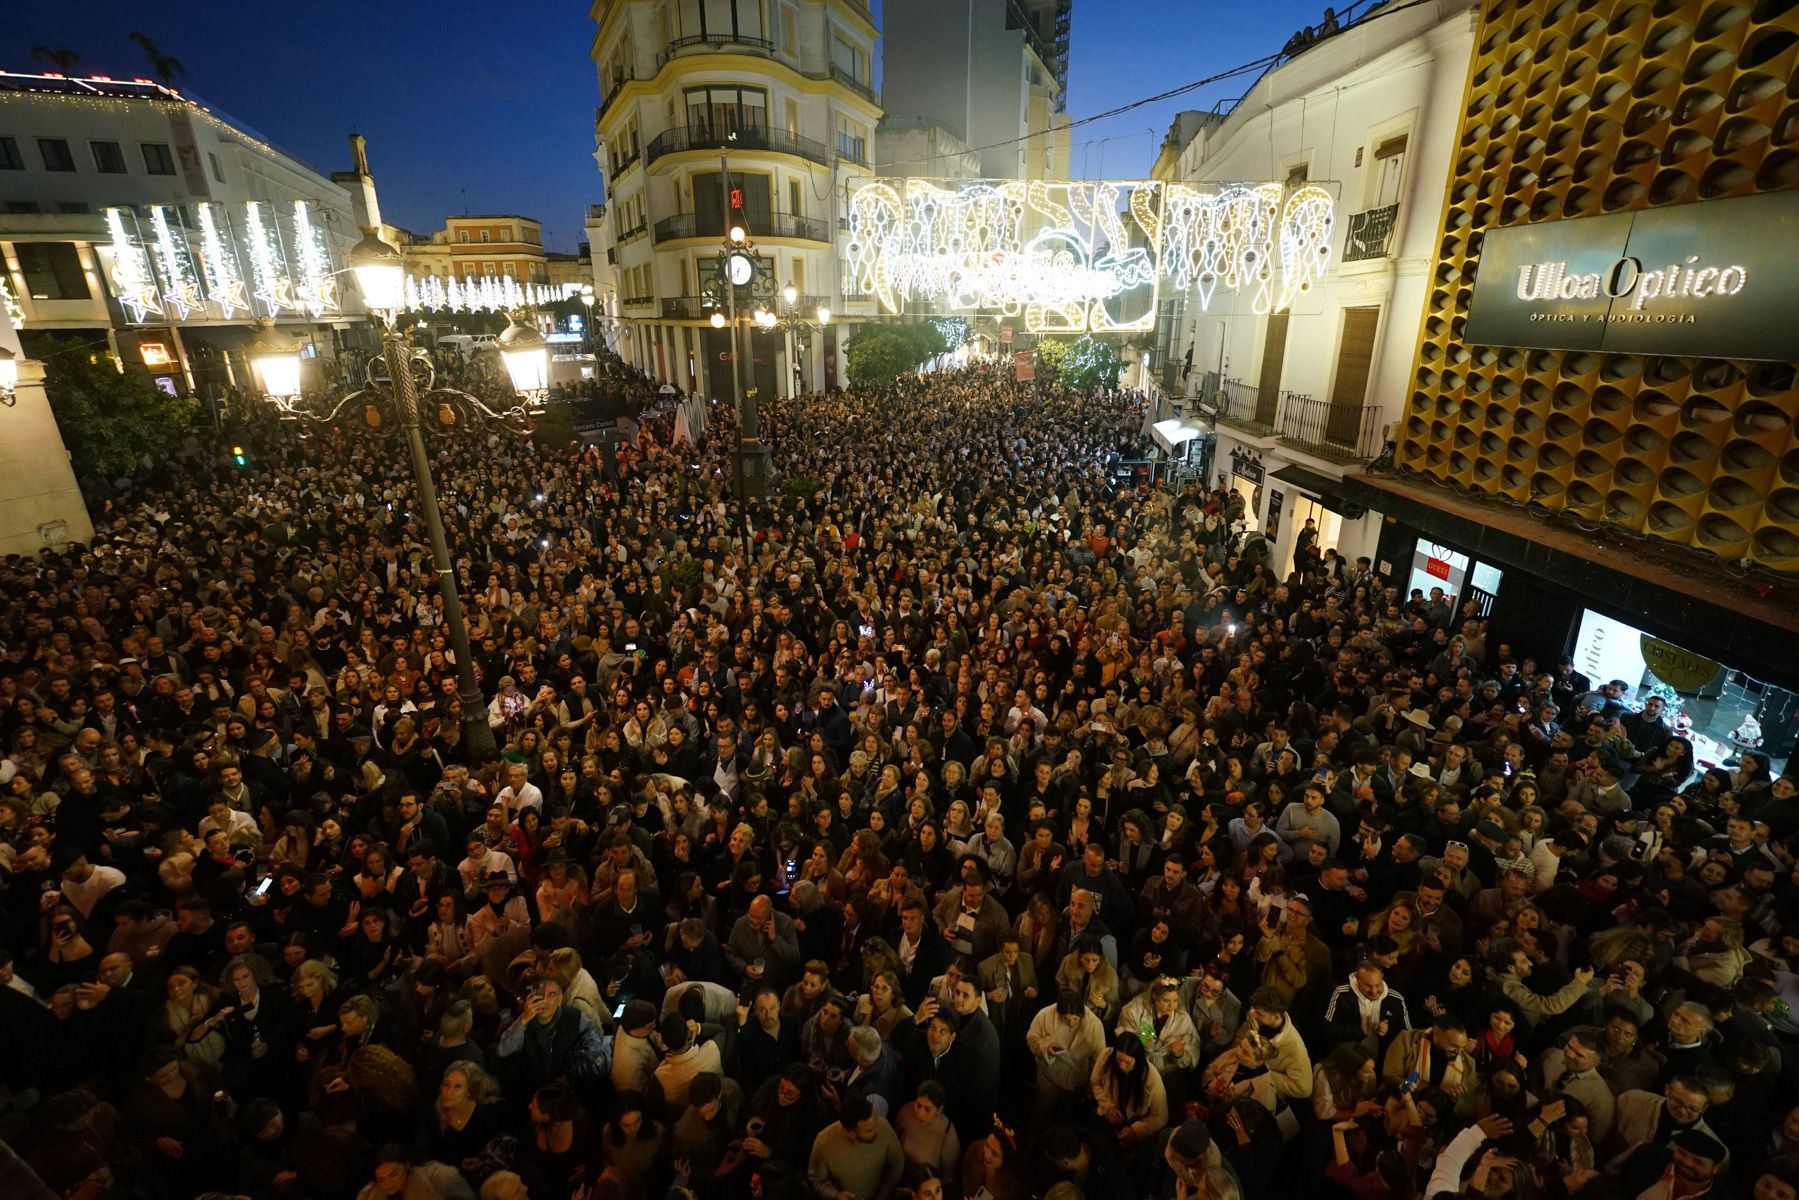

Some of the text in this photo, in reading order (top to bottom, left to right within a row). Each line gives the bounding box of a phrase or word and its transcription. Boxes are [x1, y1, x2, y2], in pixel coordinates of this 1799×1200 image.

[1516, 261, 1600, 301] Ulloa
[1530, 313, 1575, 322] ÓPTICA
[1597, 313, 1698, 324] AUDIOLOGÍA
[1428, 562, 1448, 575] GUESS
